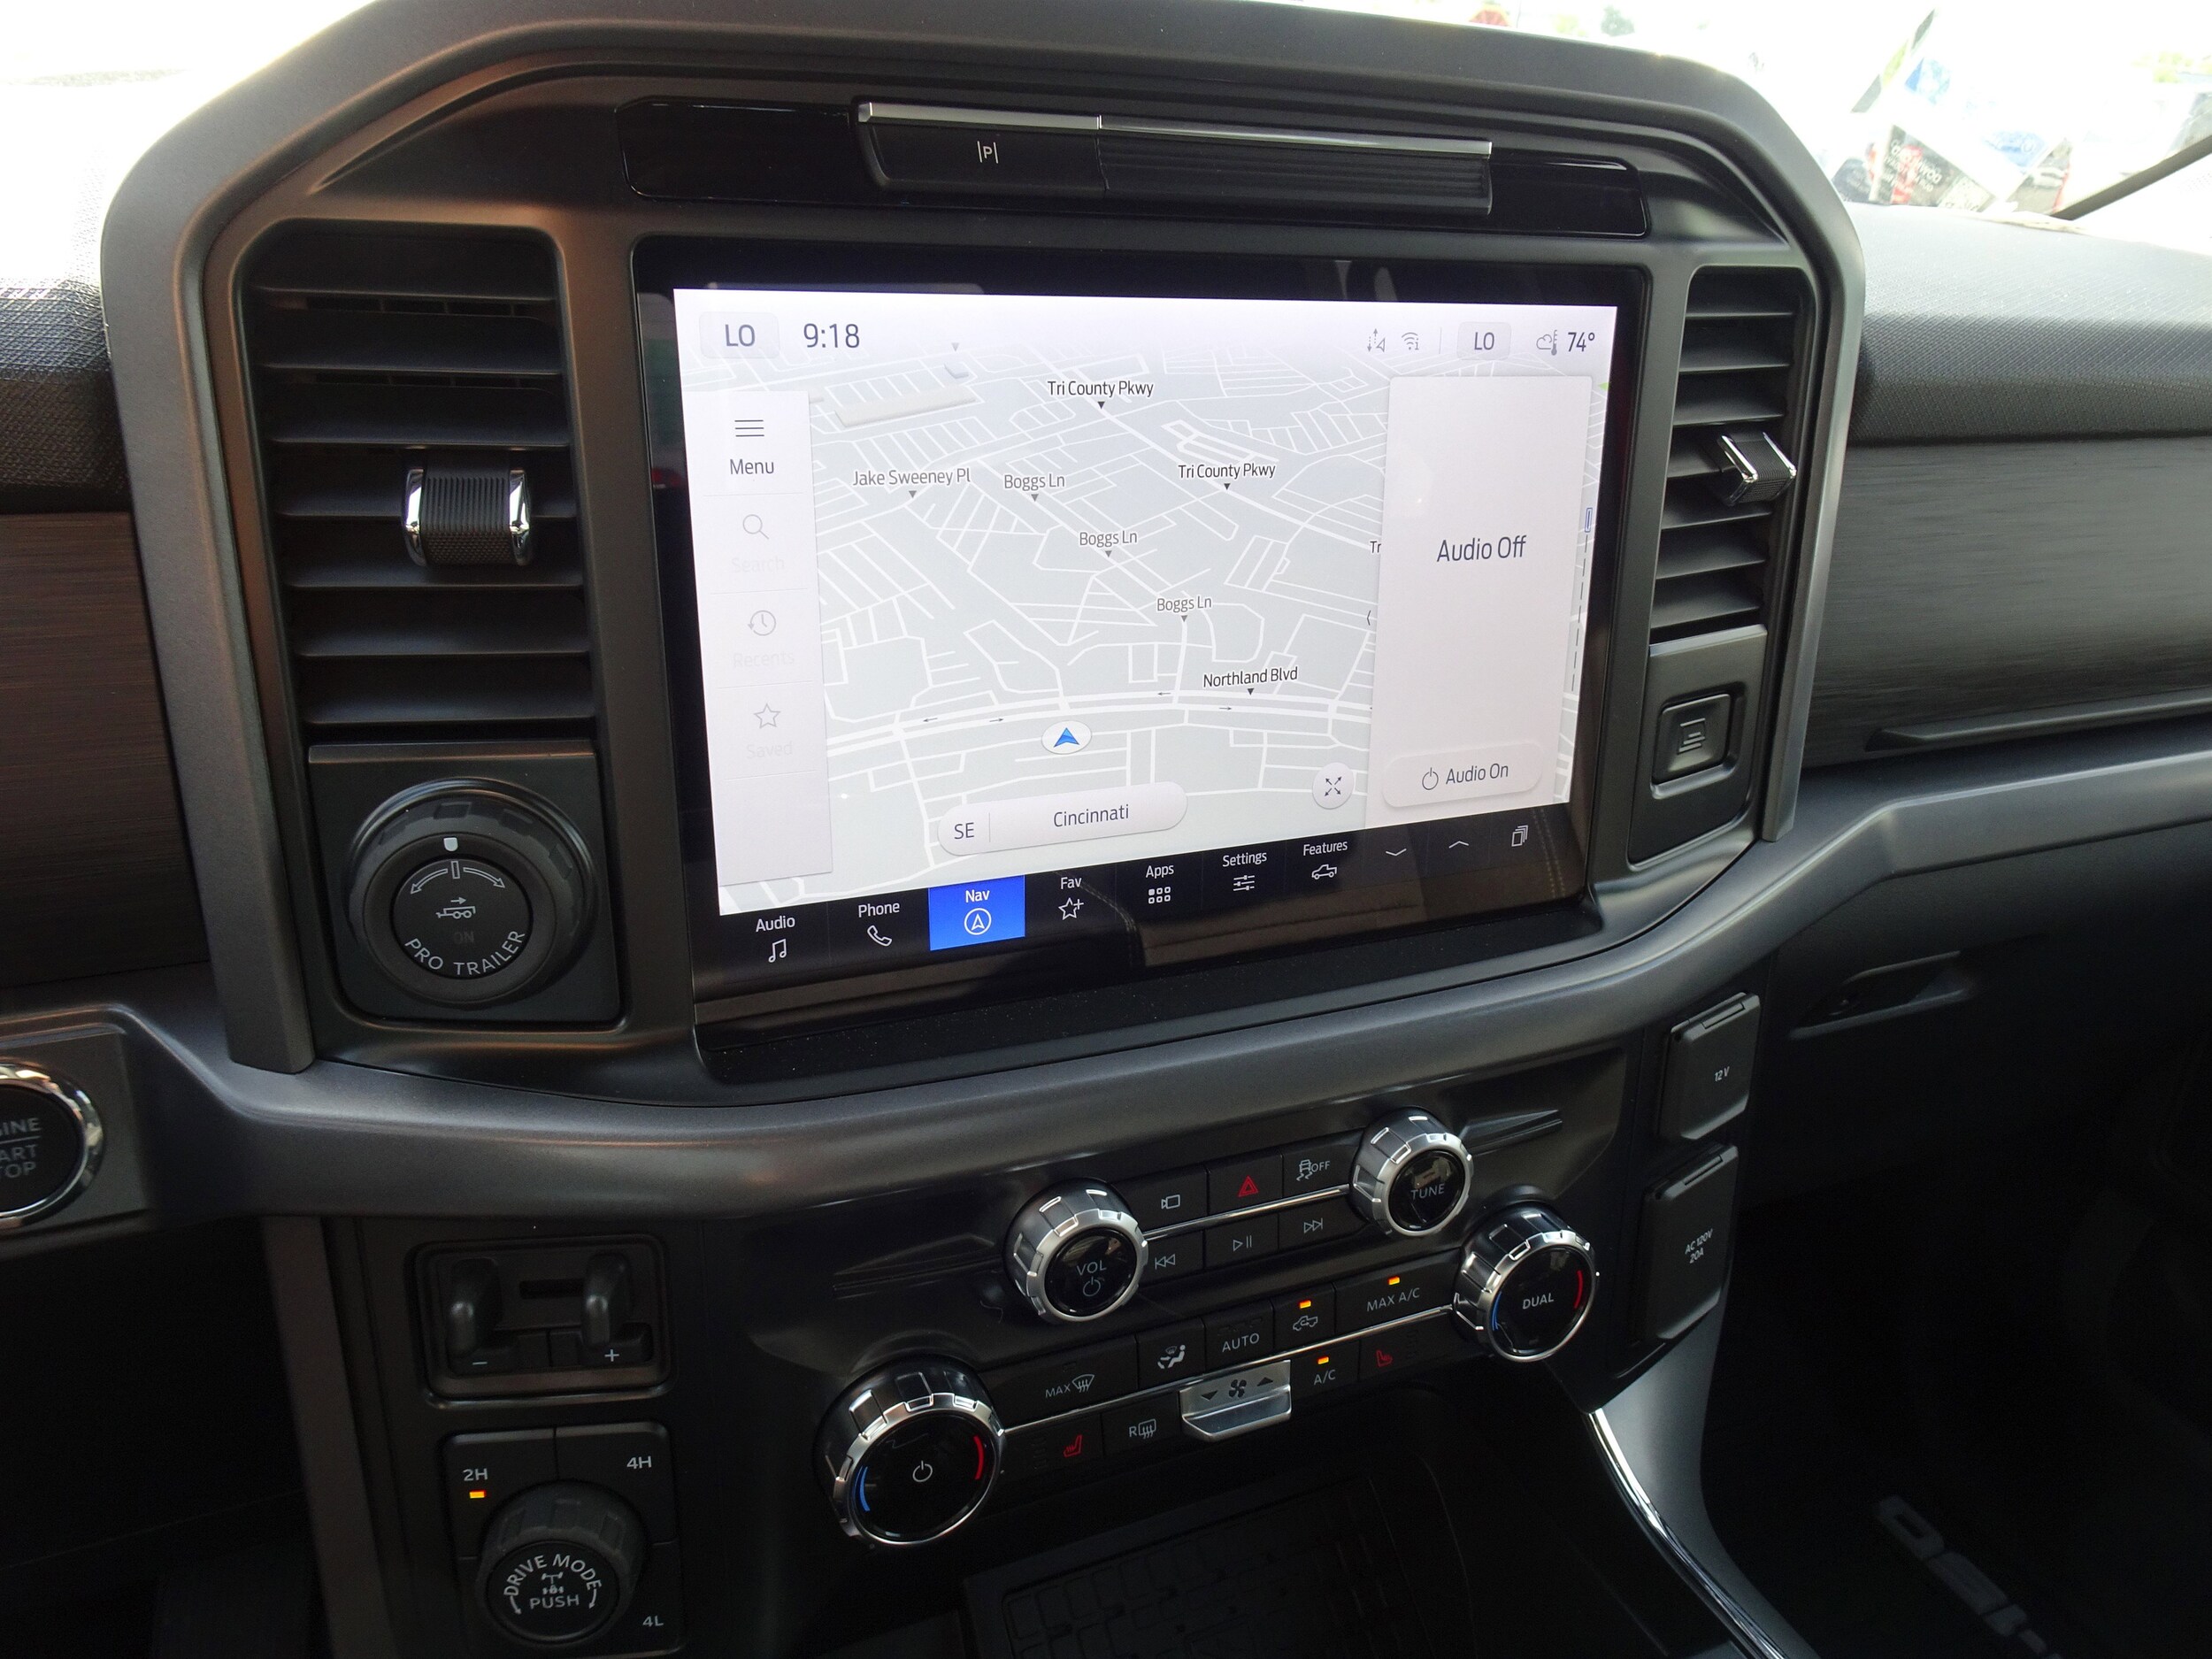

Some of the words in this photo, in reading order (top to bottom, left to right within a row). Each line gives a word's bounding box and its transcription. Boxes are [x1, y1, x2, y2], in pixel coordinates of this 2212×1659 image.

[725, 323, 757, 348] LO
[803, 322, 861, 349] 9:18
[1473, 331, 1495, 351] LO
[1567, 331, 1596, 352] 74°
[1047, 380, 1065, 396] Tri
[1067, 380, 1116, 399] County
[1118, 380, 1154, 398] Pkwy
[729, 457, 775, 475] Menu
[1178, 464, 1194, 479] Tri
[1196, 463, 1240, 480] County
[1243, 462, 1276, 479] Pkwy
[852, 470, 886, 487] Jake
[888, 469, 954, 488] Sweeney
[956, 467, 972, 483] Pl
[1003, 473, 1047, 492] Boggs
[1048, 472, 1065, 488] Ln
[1079, 531, 1120, 549] Boggs
[1122, 530, 1138, 544] Ln
[1436, 537, 1493, 563] Audio
[1496, 534, 1528, 559] Off
[731, 555, 786, 573] Search
[1156, 597, 1195, 614] Boggs
[1196, 596, 1212, 611] Ln
[732, 650, 795, 669] Recents
[1202, 668, 1268, 688] Northland
[1270, 665, 1299, 682] Blvd
[746, 740, 794, 759] Saved
[1445, 764, 1487, 785] Audio
[1489, 762, 1509, 780] On
[1053, 803, 1130, 828] Cincinnati
[953, 821, 975, 840] SE
[1302, 839, 1349, 857] Features
[1222, 850, 1268, 869] Settings
[1145, 864, 1175, 879] Apps
[1060, 876, 1083, 890] Fav
[964, 888, 991, 903] Nav
[857, 902, 901, 918] Phone
[755, 914, 796, 933] Audio
[404, 938, 444, 971] PRO
[453, 930, 526, 976] TRAILER
[0, 1117, 42, 1137] INE
[0, 1161, 36, 1179] OP
[1310, 1160, 1331, 1173] OFF
[1409, 1182, 1446, 1201] TUNE
[1075, 1259, 1107, 1278] VOL
[1365, 1293, 1396, 1313] MAX
[1397, 1286, 1421, 1307] A/C
[1522, 1292, 1555, 1310] DUAL
[1221, 1333, 1260, 1353] AUTO
[1313, 1369, 1336, 1386] A/C
[1045, 1383, 1071, 1399] MAX
[626, 1455, 653, 1470] 4H
[462, 1467, 488, 1482] 2H
[503, 1553, 549, 1597] DRIVE
[552, 1553, 603, 1591] MODE
[529, 1594, 580, 1610] PUSH
[642, 1615, 664, 1628] 4L
